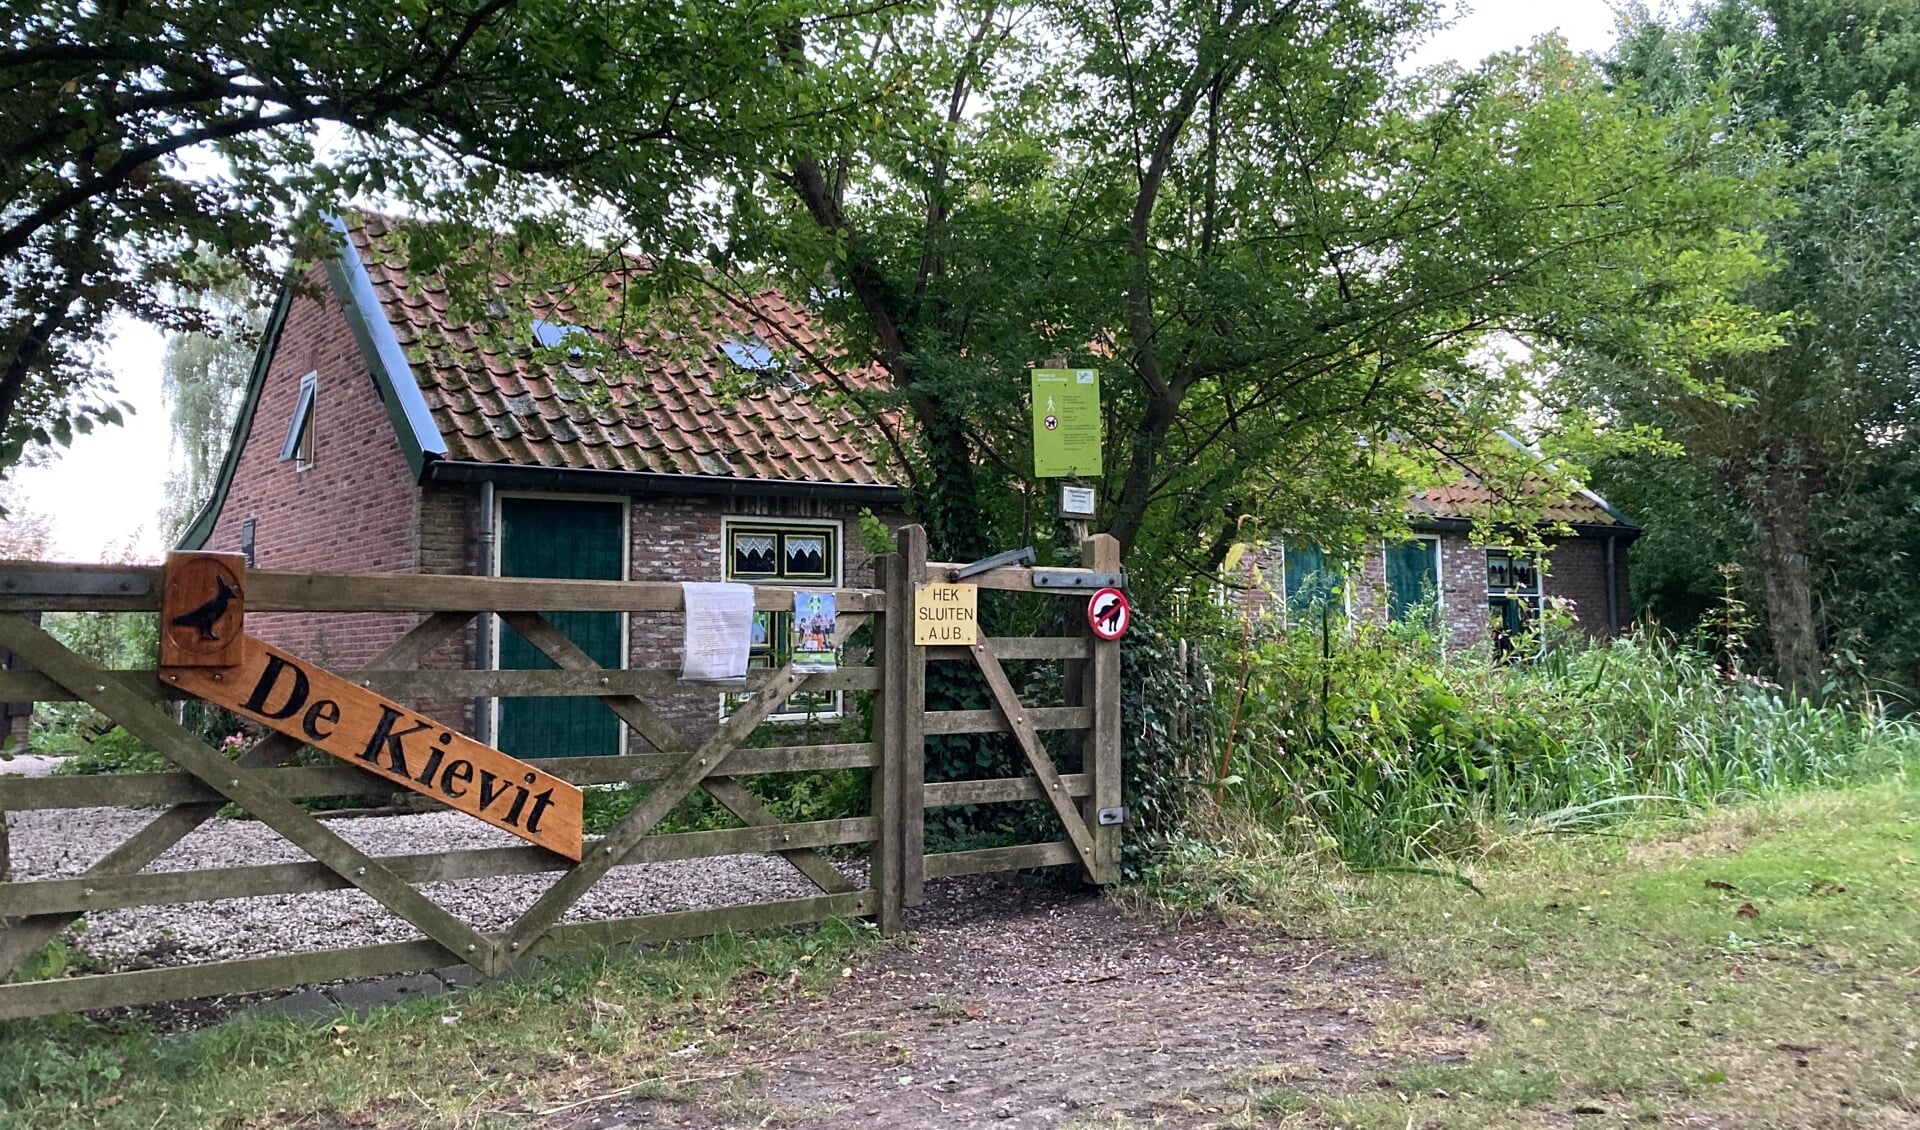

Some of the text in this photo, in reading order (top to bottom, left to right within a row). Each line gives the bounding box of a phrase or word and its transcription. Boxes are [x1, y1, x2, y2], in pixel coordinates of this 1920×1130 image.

[933, 588, 959, 601] HEK
[919, 607, 973, 621] SLUITEN
[238, 652, 555, 835] De Kievit
